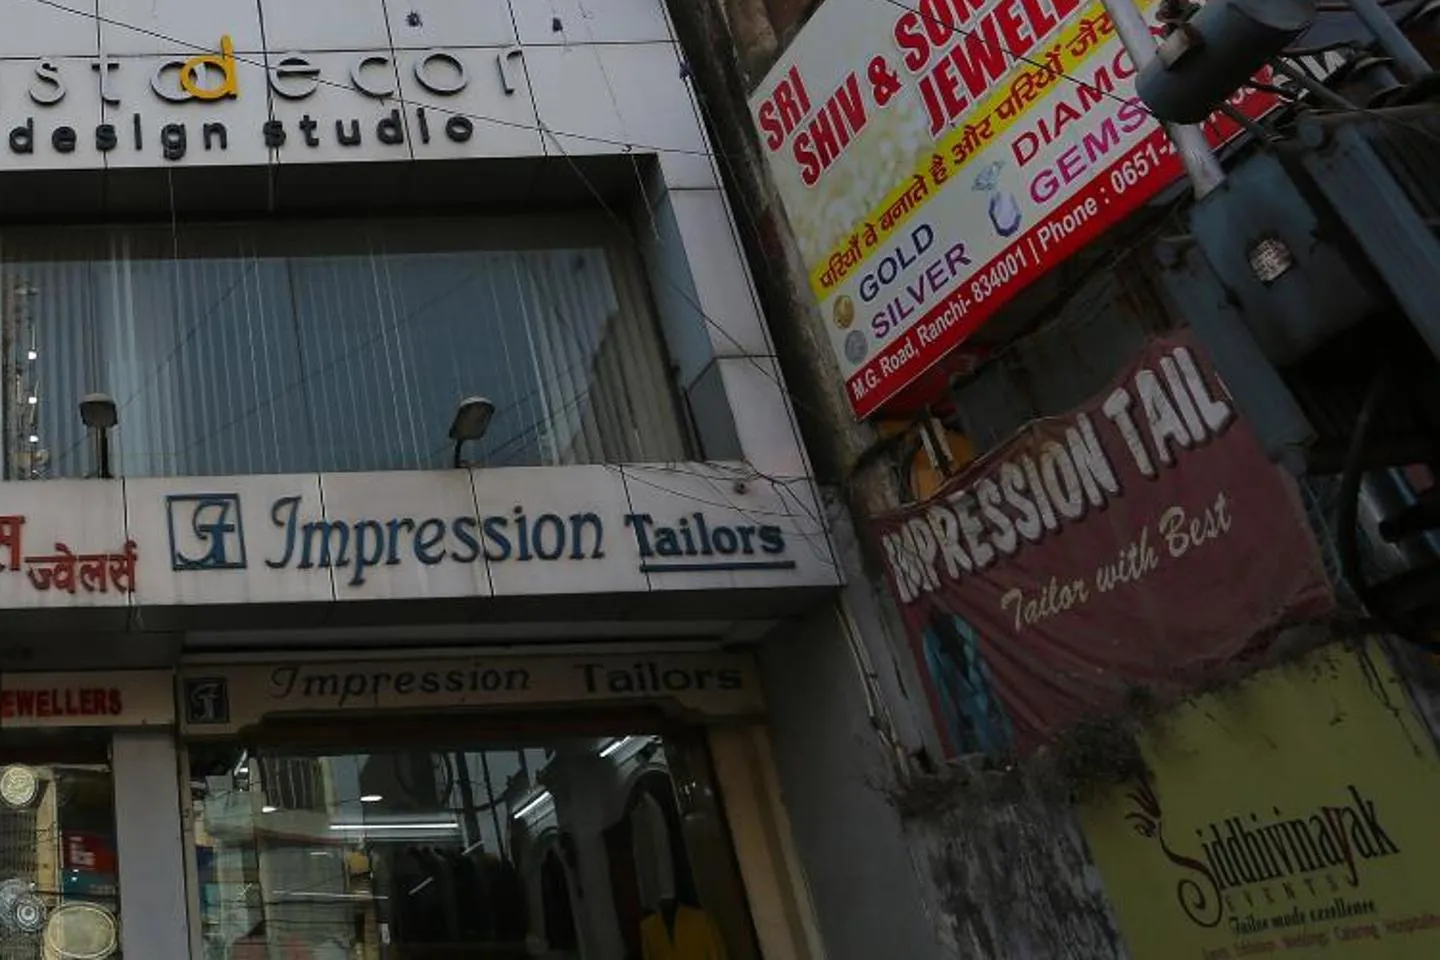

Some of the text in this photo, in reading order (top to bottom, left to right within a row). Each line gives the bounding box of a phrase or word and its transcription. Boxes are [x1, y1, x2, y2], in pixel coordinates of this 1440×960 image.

[9, 107, 474, 161] design studio
[758, 66, 812, 151] SRI
[793, 72, 868, 188] SHIV
[867, 54, 903, 107] &
[1029, 96, 1150, 204] GEMS
[859, 223, 935, 303] GOLD
[871, 242, 973, 339] SILVER
[880, 341, 921, 376] Road,
[974, 248, 1030, 305] 834001
[1038, 200, 1098, 253] Phone
[265, 494, 786, 587] Impression Tailors
[882, 411, 1122, 604] IMPRESSION
[25, 540, 138, 595] ज्वेलर्स
[1000, 490, 1232, 633] Tailor with Best
[269, 660, 744, 706] Impression Tailors
[1161, 784, 1400, 928] Siddhivinayak
